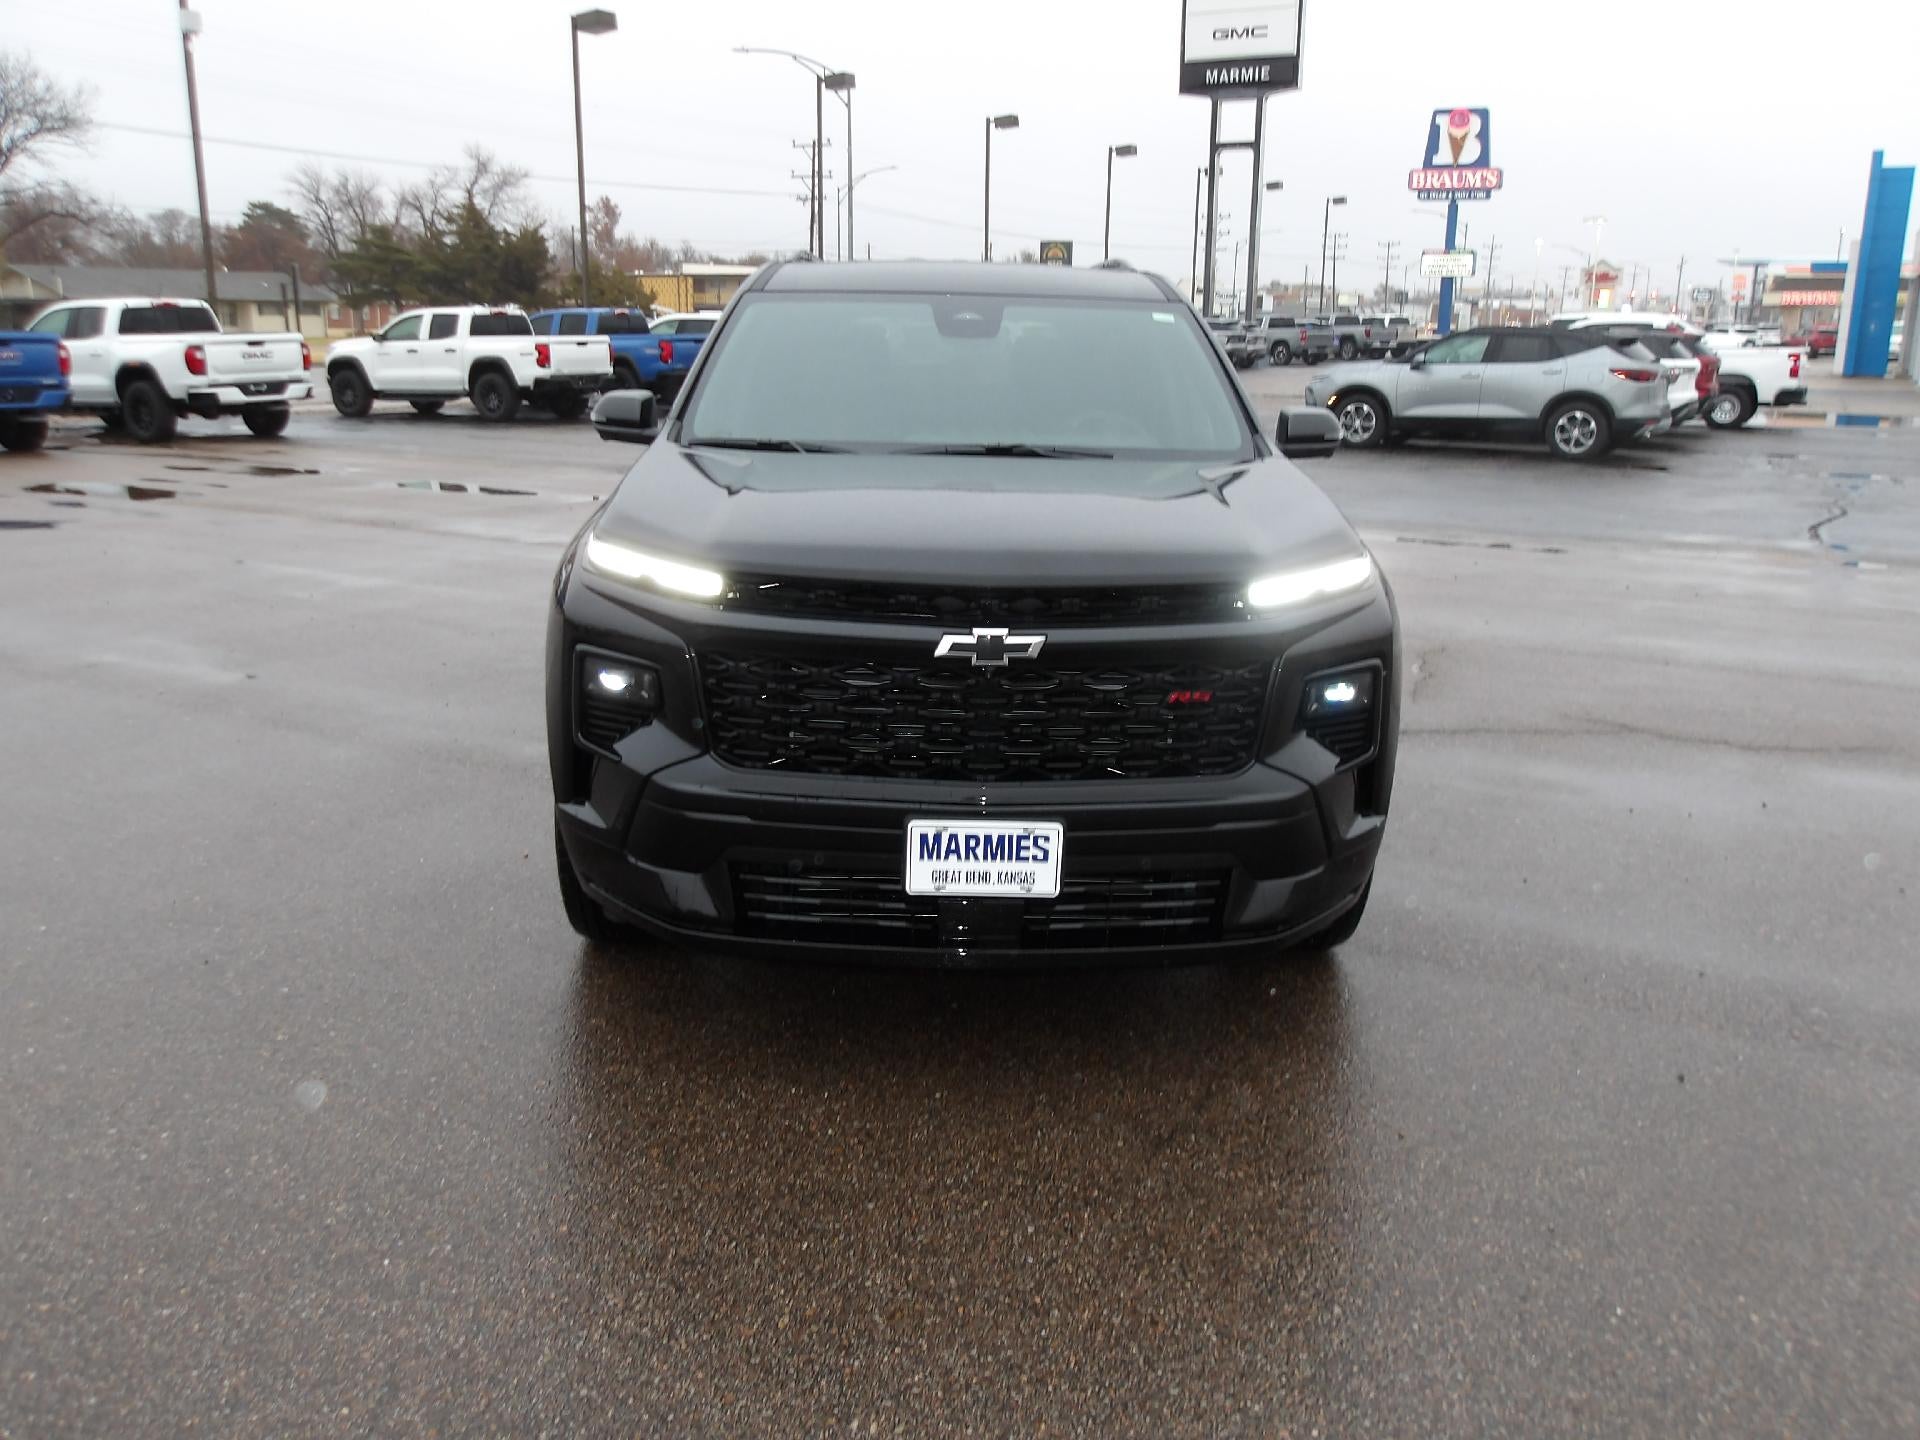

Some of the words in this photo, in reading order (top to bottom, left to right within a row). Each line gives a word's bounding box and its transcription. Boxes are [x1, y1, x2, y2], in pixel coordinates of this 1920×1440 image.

[1212, 24, 1268, 40] GMC
[1206, 65, 1270, 85] MARMIE
[1411, 169, 1498, 189] BRAUM'S
[242, 352, 273, 360] GMC
[918, 831, 1051, 864] MARMIES
[931, 869, 963, 885] GREAT
[997, 871, 1036, 886] KANSAS
